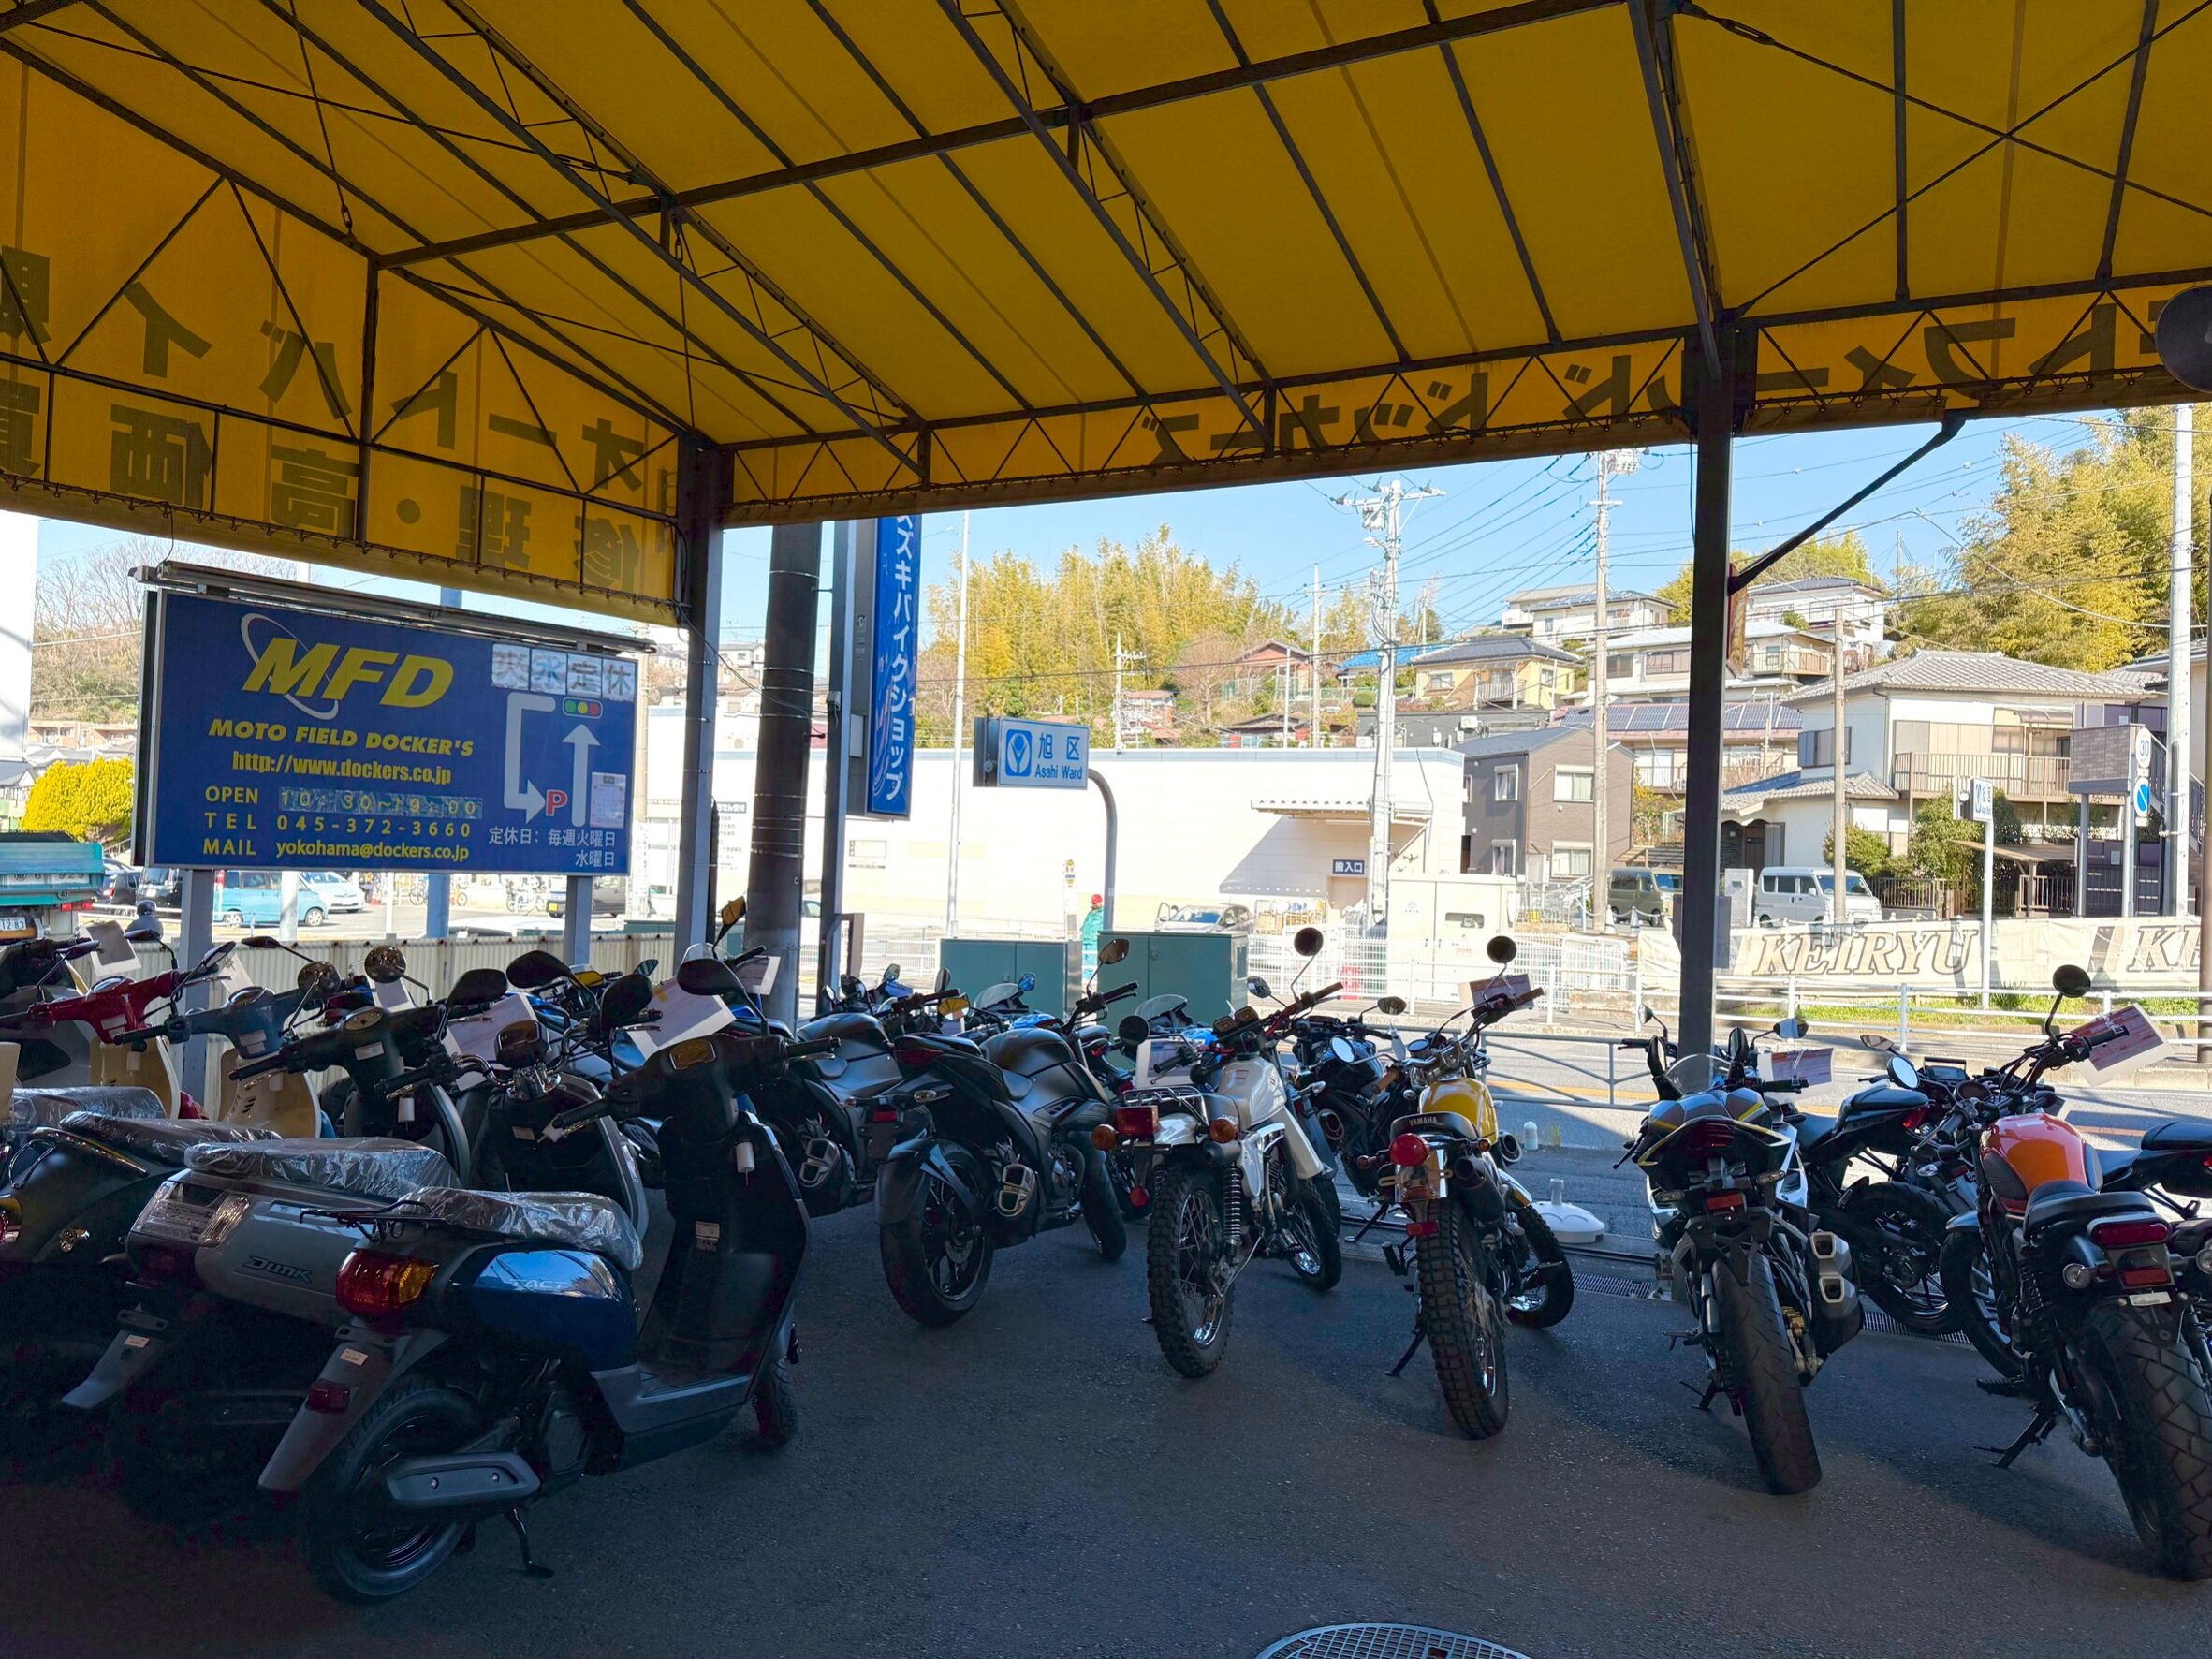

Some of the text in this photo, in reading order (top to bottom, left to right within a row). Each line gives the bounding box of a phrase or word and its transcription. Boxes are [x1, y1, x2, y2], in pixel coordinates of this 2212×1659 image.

[242, 637, 455, 708] MFD
[208, 718, 474, 756] MOTO FIELD DOCKER'S
[2139, 740, 2150, 756] 30
[232, 750, 452, 785] http://www.dockers.co.jp
[1034, 764, 1083, 780] Asahi Ward
[205, 785, 259, 805] OPEN
[546, 789, 568, 816] P
[204, 812, 471, 837] TEL 045-372-3660
[548, 828, 616, 847] 毎週火曜日
[203, 838, 470, 862] MAIL yokohama@dockers.co.jp
[575, 850, 615, 868] 水曜日
[1752, 929, 1980, 976] KEIRYU
[1408, 1115, 1438, 1127] YAMAHA
[508, 1278, 568, 1289] TACT
